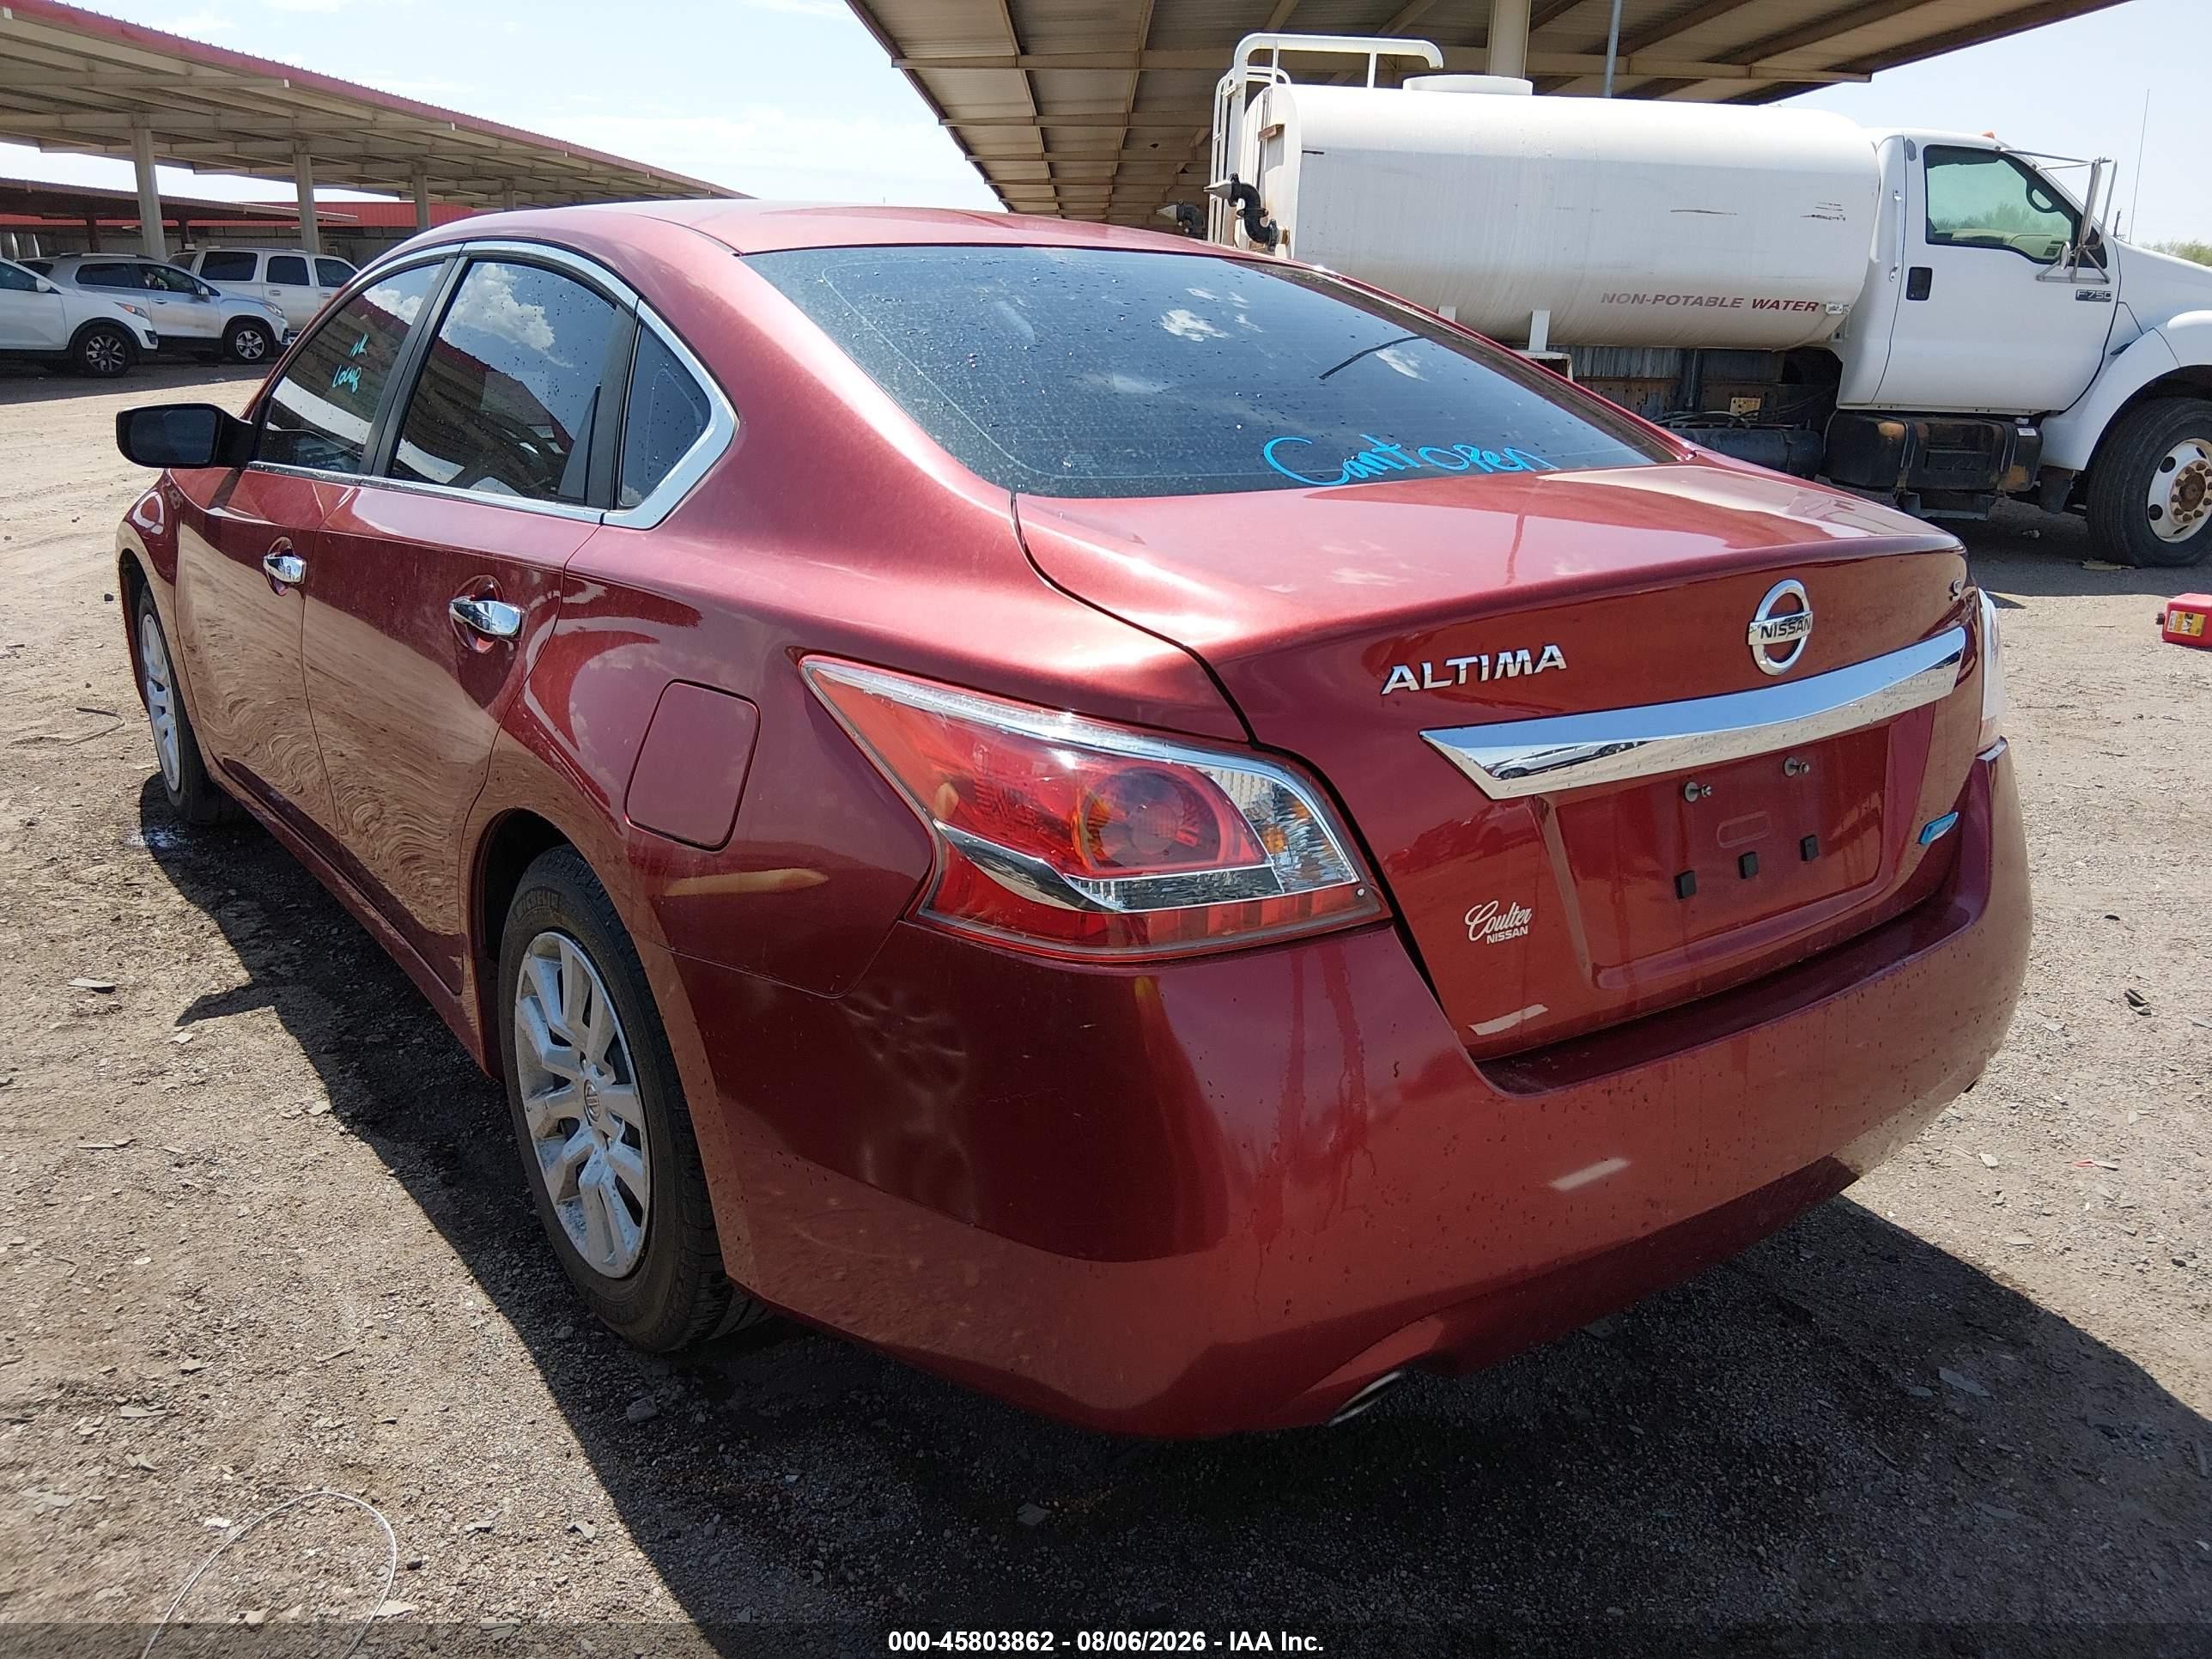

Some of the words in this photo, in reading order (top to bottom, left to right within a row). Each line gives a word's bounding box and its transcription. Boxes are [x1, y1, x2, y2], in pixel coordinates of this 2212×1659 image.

[1601, 292, 1745, 309] NON-POTABLE
[1751, 298, 1820, 313] WATER
[1760, 617, 1811, 640] NISSAN
[1380, 644, 1567, 696] ALTIMA
[1464, 900, 1533, 942] Coulter
[1486, 925, 1529, 945] NISSAN
